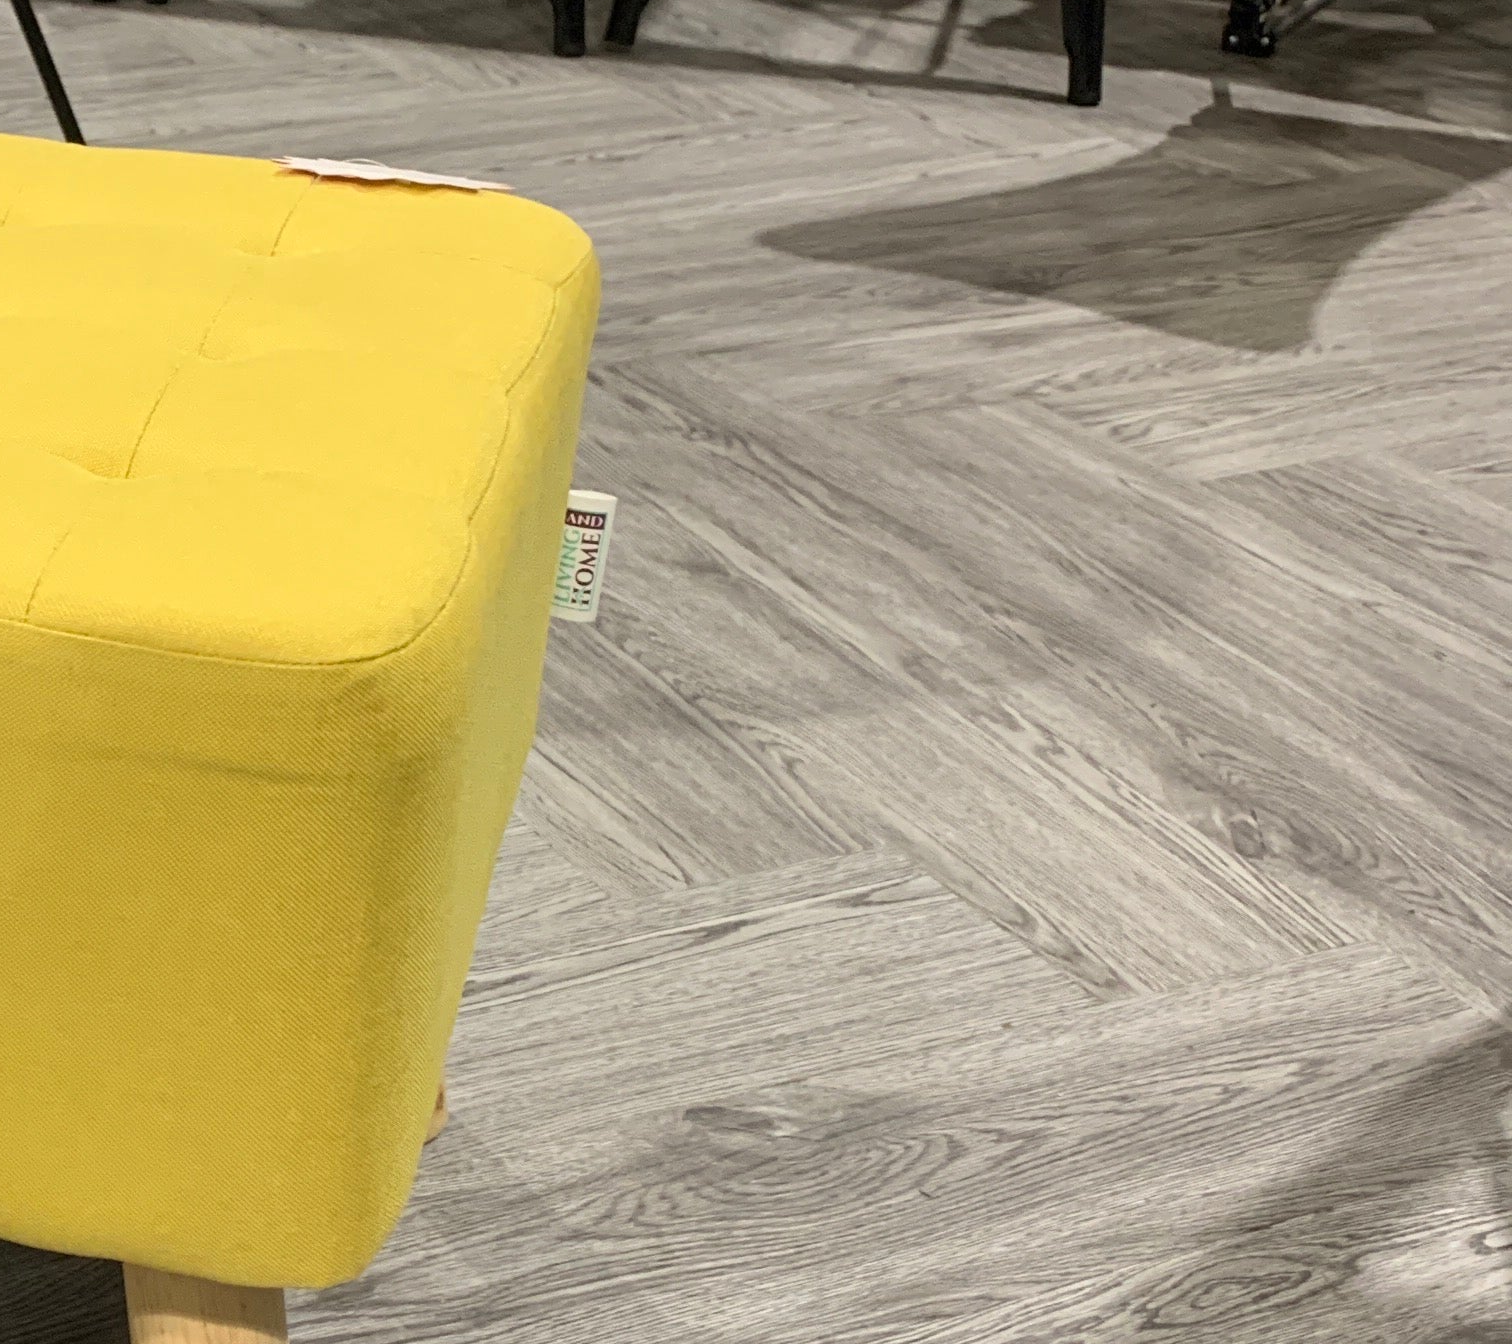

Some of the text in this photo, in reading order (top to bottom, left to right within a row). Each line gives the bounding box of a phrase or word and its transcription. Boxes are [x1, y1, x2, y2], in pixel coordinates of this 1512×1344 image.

[566, 513, 604, 528] AND
[554, 528, 581, 602] LIVING
[571, 533, 601, 605] HOME
